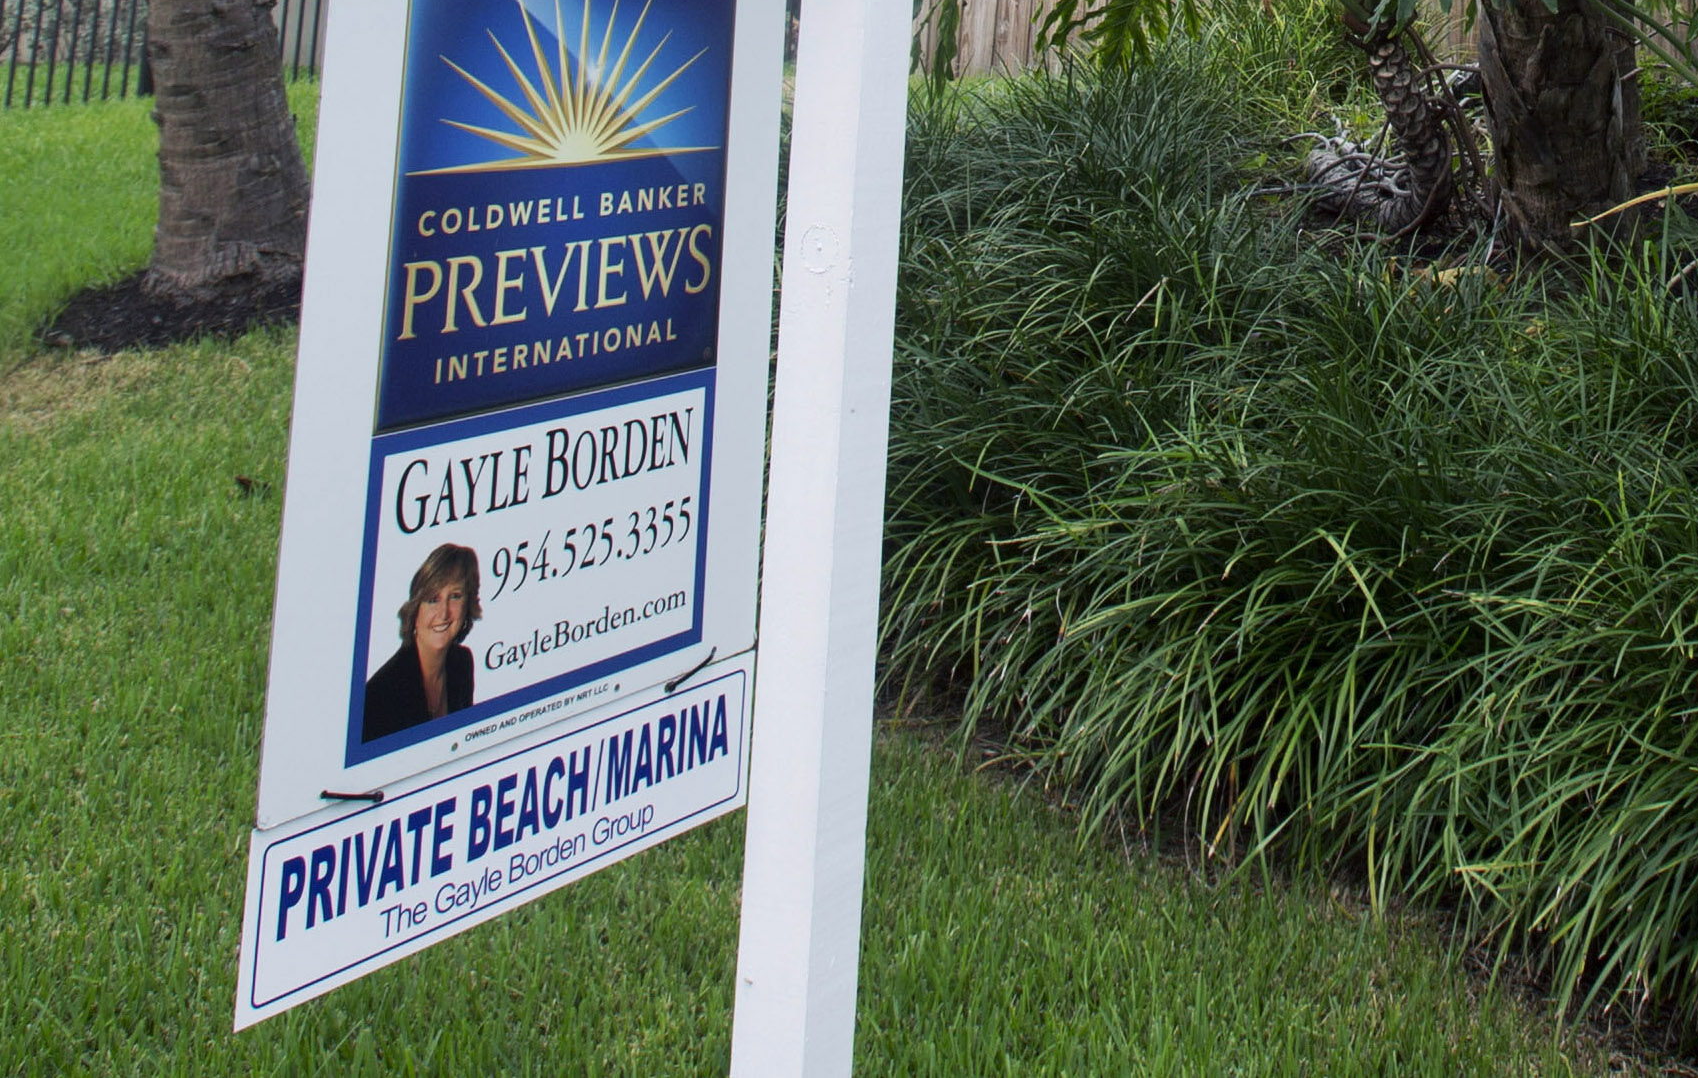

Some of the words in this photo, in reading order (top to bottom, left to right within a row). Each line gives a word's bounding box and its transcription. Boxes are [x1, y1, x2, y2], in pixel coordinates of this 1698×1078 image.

[418, 196, 584, 238] COLDWELL
[600, 183, 706, 217] BANKER
[397, 224, 713, 341] PREVIEWS
[435, 318, 677, 384] INTERNATIONAL
[489, 496, 692, 602] 954.525.3355
[484, 589, 687, 672] GayleBorden.com
[465, 723, 497, 742] OWNED
[499, 717, 517, 729] AND
[518, 700, 563, 723] OPERATED
[564, 695, 576, 707] BY
[576, 688, 593, 702] NRT
[594, 683, 609, 695] LLC
[276, 797, 457, 942] PRIVATE
[467, 694, 729, 863] BEACH/MARINA
[380, 900, 427, 938] The
[435, 867, 502, 909] Gayle
[509, 833, 585, 883] Borden
[592, 803, 654, 845] Group
